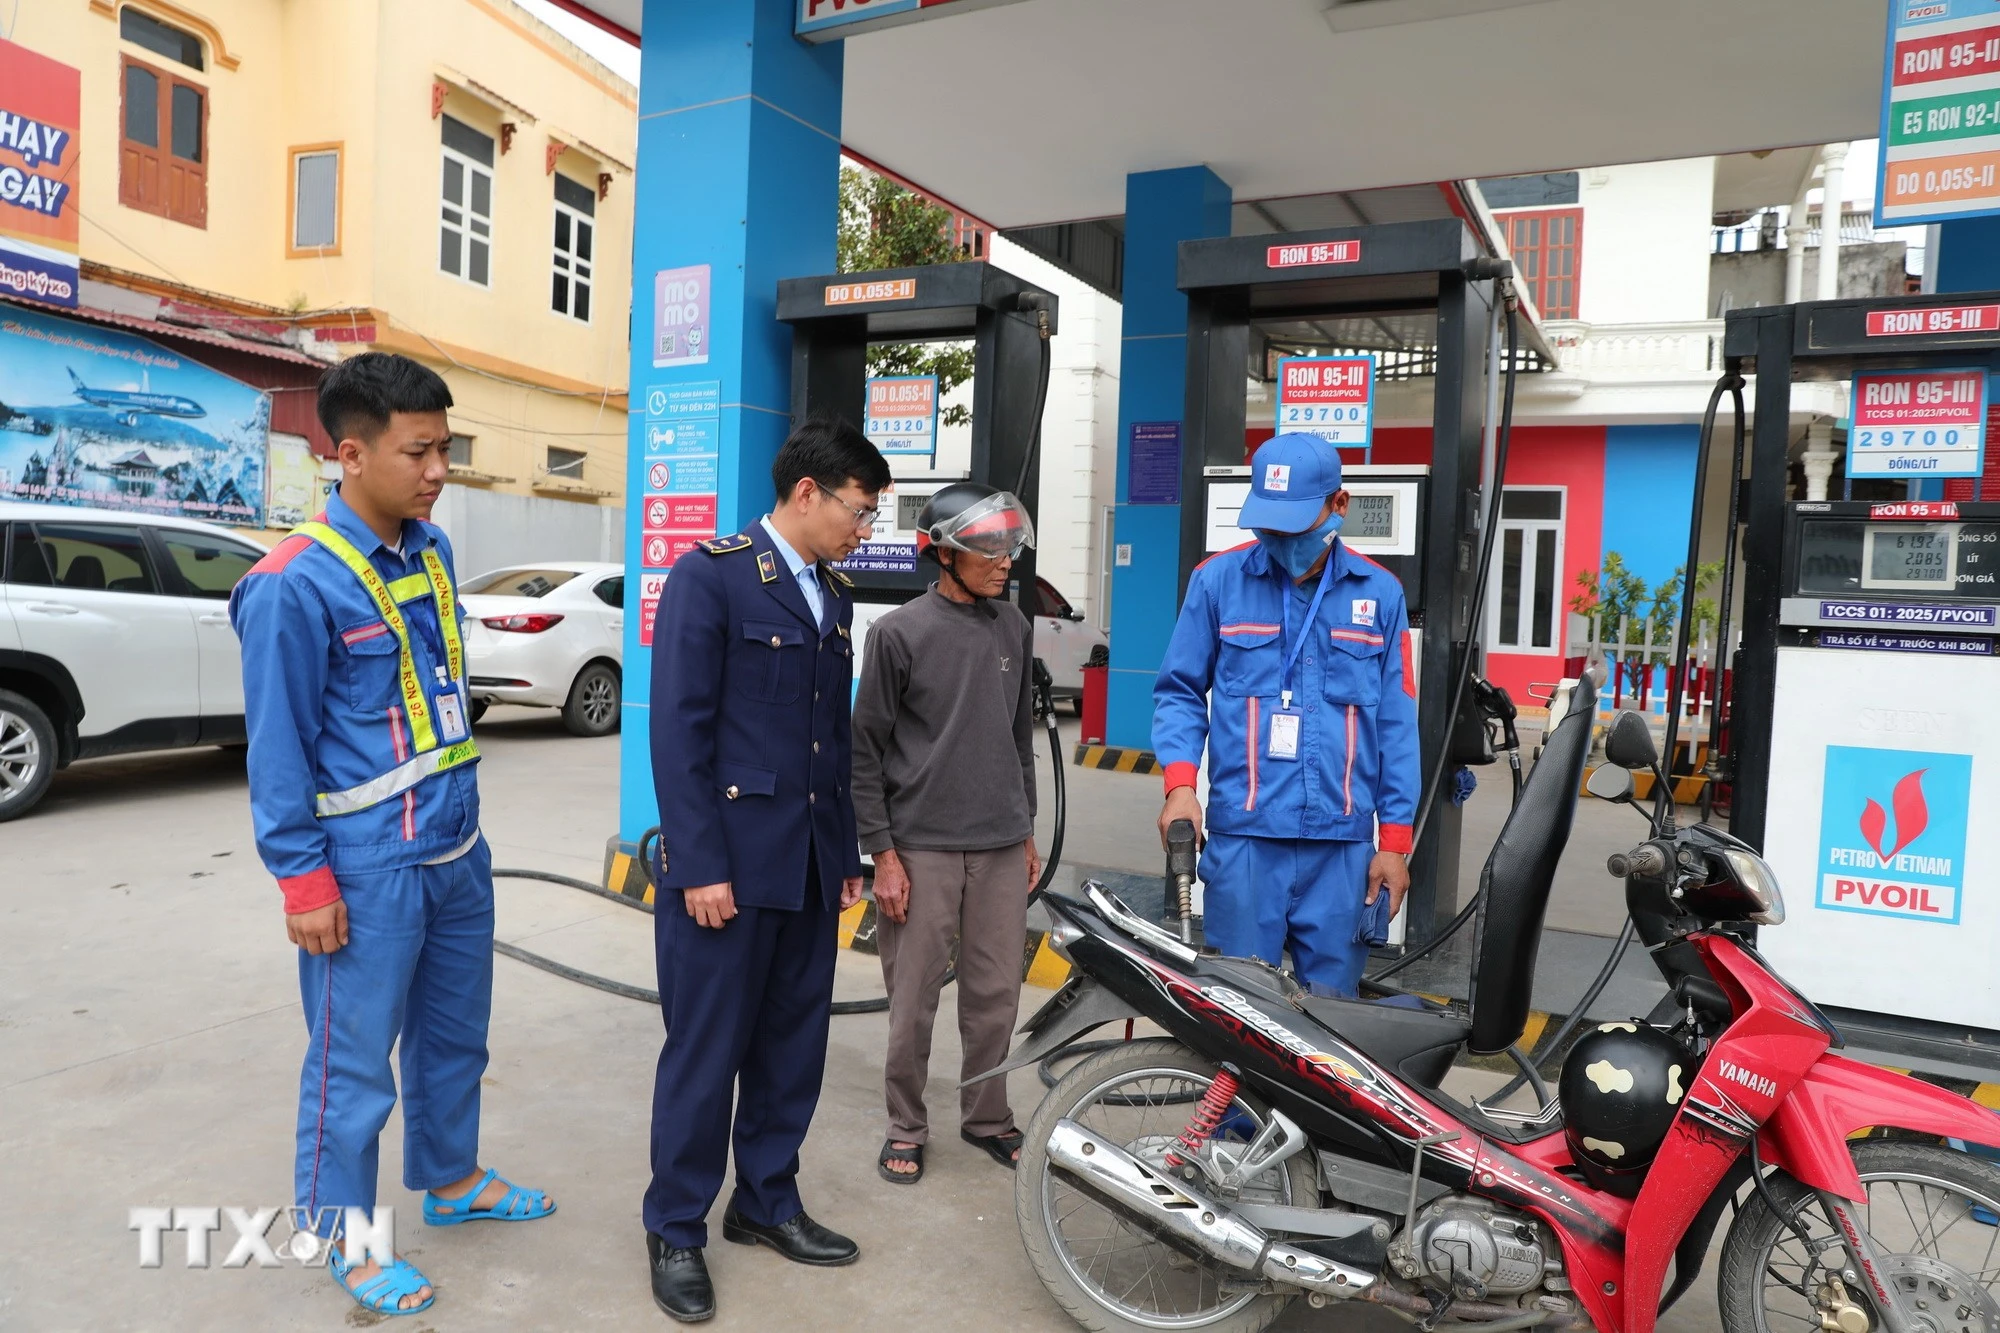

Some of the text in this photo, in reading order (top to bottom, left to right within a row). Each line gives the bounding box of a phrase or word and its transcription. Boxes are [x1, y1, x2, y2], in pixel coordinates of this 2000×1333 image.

[1908, 5, 1944, 18] PVOIL
[1902, 38, 2000, 75] RON 95-II
[1902, 101, 2000, 135] E5 RON 92-I
[1896, 165, 1994, 195] DO 0,05S-II
[1280, 244, 1347, 264] RON 95-III
[52, 282, 69, 296] xe
[830, 281, 910, 302] DO 0,05S-II
[1883, 309, 1982, 333] RON 95-III
[1287, 366, 1364, 387] RON 95-III
[872, 386, 886, 402] DO
[1288, 390, 1308, 398] TCCS
[1865, 380, 1976, 405] RON 95-III
[1289, 407, 1359, 421] 29700
[1865, 408, 1973, 419] TCCS 01:2023/PVOIL
[871, 419, 923, 432] 31320
[1859, 429, 1959, 447] 29700
[1875, 505, 1906, 516] RON
[1910, 505, 1929, 516] 95
[1982, 531, 1997, 543] SỐ
[867, 546, 913, 556] 2025/PVOIL
[1905, 552, 1943, 566] 2.085
[1967, 552, 1980, 563] LÍT
[427, 555, 450, 617] E5 RON 92
[1976, 572, 1995, 583] GIÁ
[363, 568, 405, 631] E5 RON 92
[1827, 605, 1988, 623] TCCS 01: 2025/PVOIL
[447, 639, 459, 654] E5
[1826, 634, 1845, 645] TRẢ
[1847, 634, 1862, 646] SỐ
[1899, 638, 1936, 649] TRƯỚC
[1938, 641, 1957, 650] KHI
[1959, 641, 1986, 651] BƠM
[401, 651, 424, 719] E5 RON 92
[1835, 879, 1940, 913] PVOIL
[1719, 1059, 1777, 1098] YAMAHA
[1705, 1111, 1753, 1137] 4-STROKE
[1465, 1147, 1572, 1203] EDITION
[1500, 1244, 1540, 1263] YAMAHA
